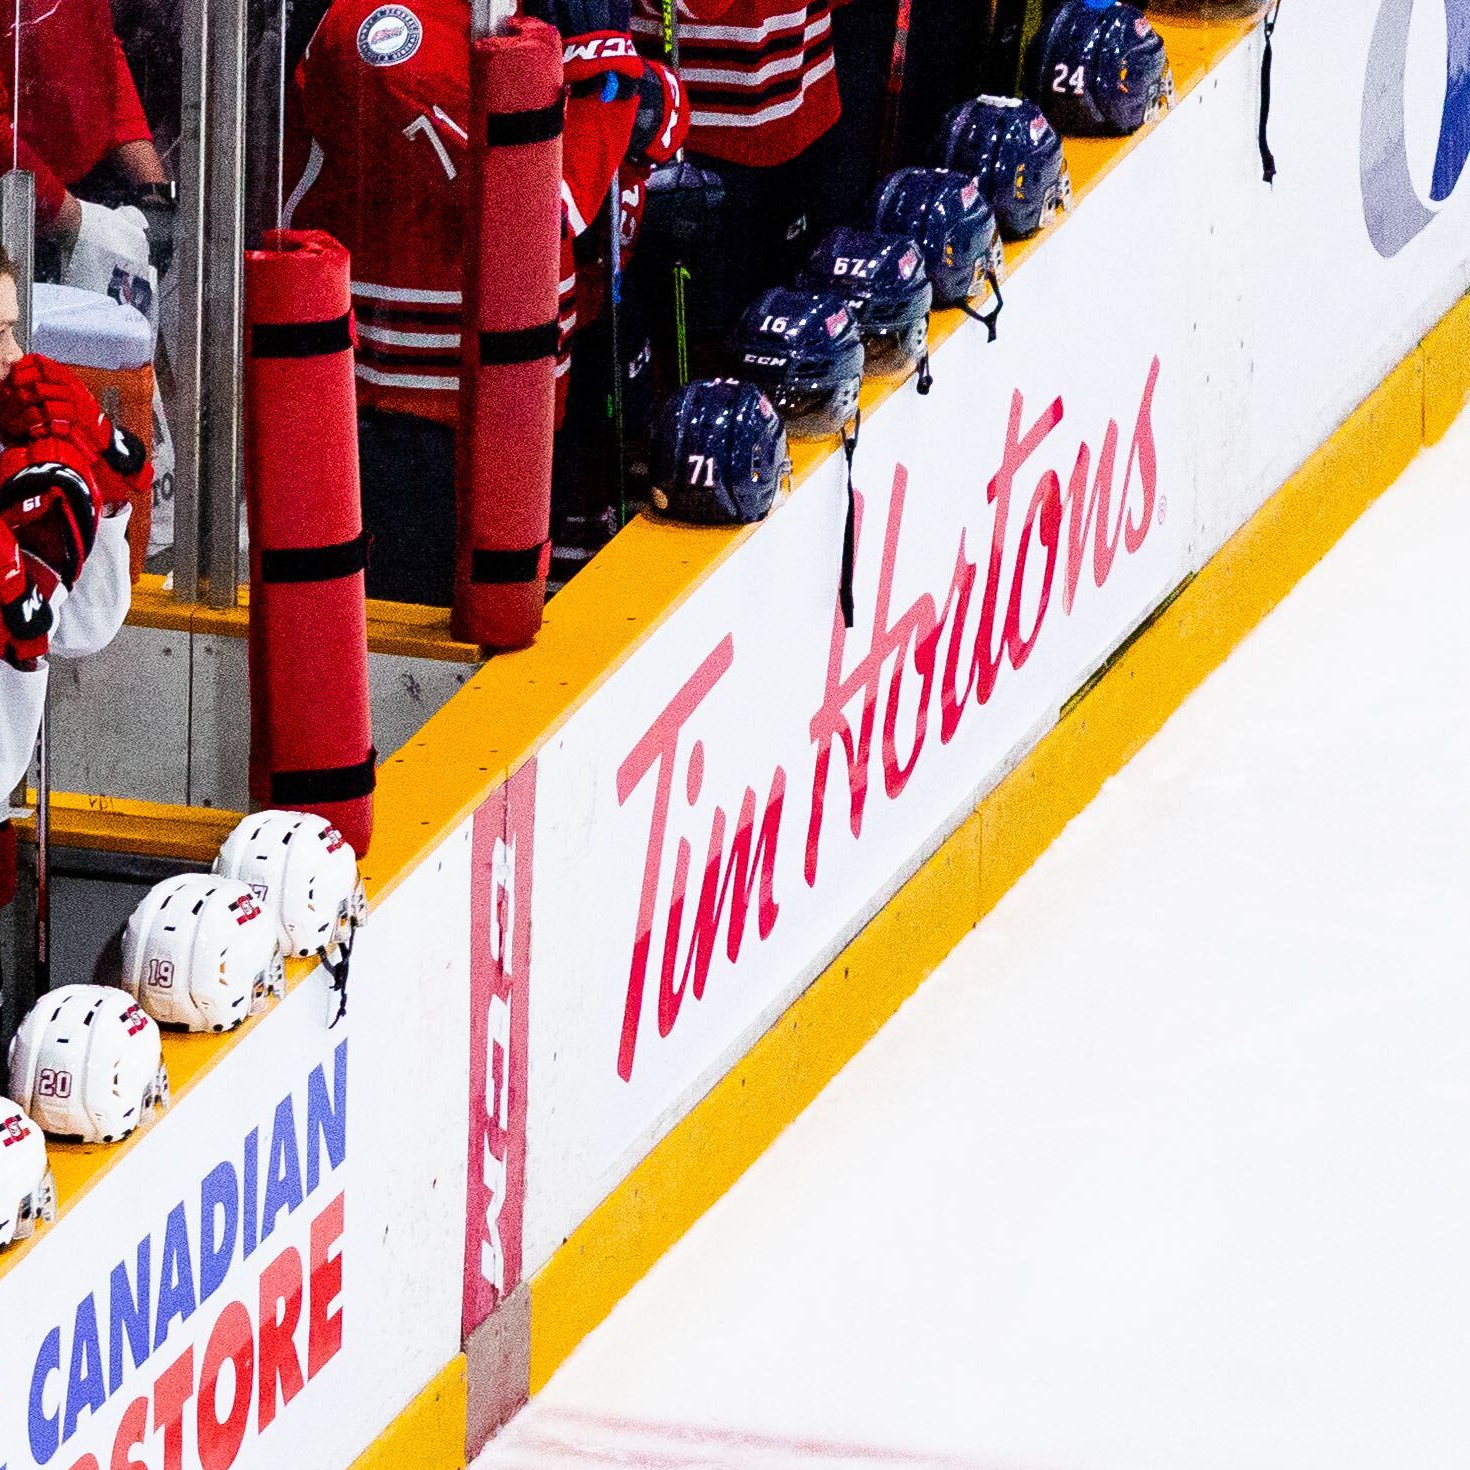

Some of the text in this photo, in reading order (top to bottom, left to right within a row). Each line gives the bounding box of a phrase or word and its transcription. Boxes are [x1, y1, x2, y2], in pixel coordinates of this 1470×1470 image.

[1052, 63, 1085, 95] 24
[833, 257, 866, 278] 67
[760, 315, 790, 334] 16
[743, 353, 787, 367] CCM
[687, 455, 715, 487] 71
[615, 356, 1159, 1083] Tim Hortons
[149, 959, 174, 989] 19
[39, 1069, 71, 1098] 20
[27, 1039, 348, 1466] CANADIAN
